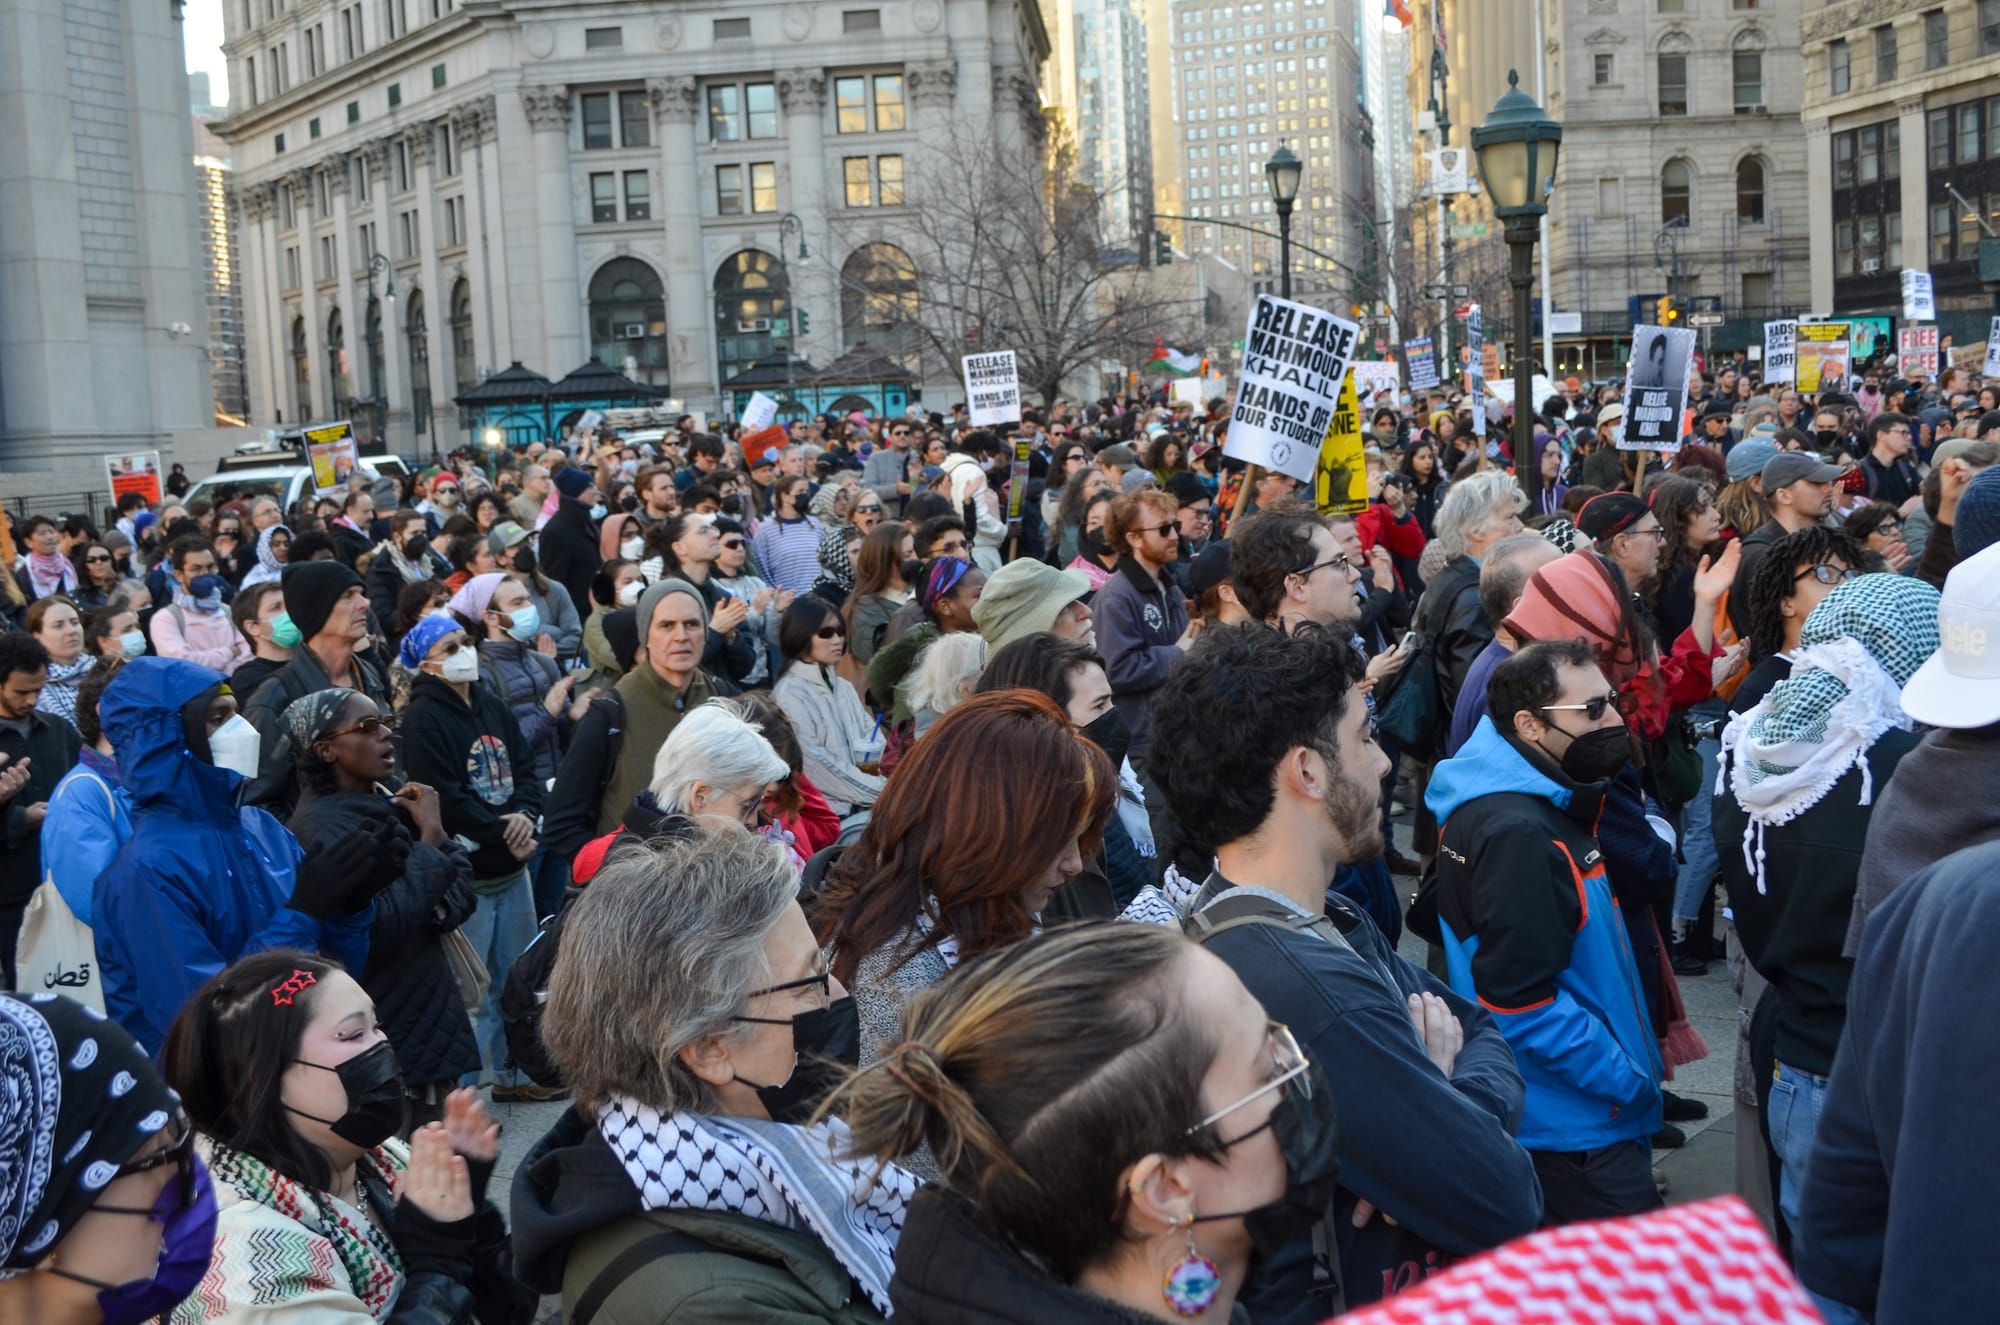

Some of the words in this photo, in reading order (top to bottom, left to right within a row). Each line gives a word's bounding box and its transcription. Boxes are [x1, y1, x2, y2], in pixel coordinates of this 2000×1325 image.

[1256, 299, 1353, 359] RELEASE
[1901, 327, 1936, 348] FREE
[968, 354, 1012, 369] RELEASE
[1249, 329, 1343, 381] MAHMOUD
[1901, 352, 1936, 371] FEE
[970, 367, 1013, 379] MAHMOUD
[1245, 354, 1334, 400] KHALIL
[974, 392, 1000, 402] HANDS
[1240, 382, 1309, 423] HANDS
[1310, 406, 1330, 432] OFF
[1235, 405, 1267, 428] OUR
[1270, 415, 1323, 449] STUDENTS
[44, 961, 91, 989] قطن
